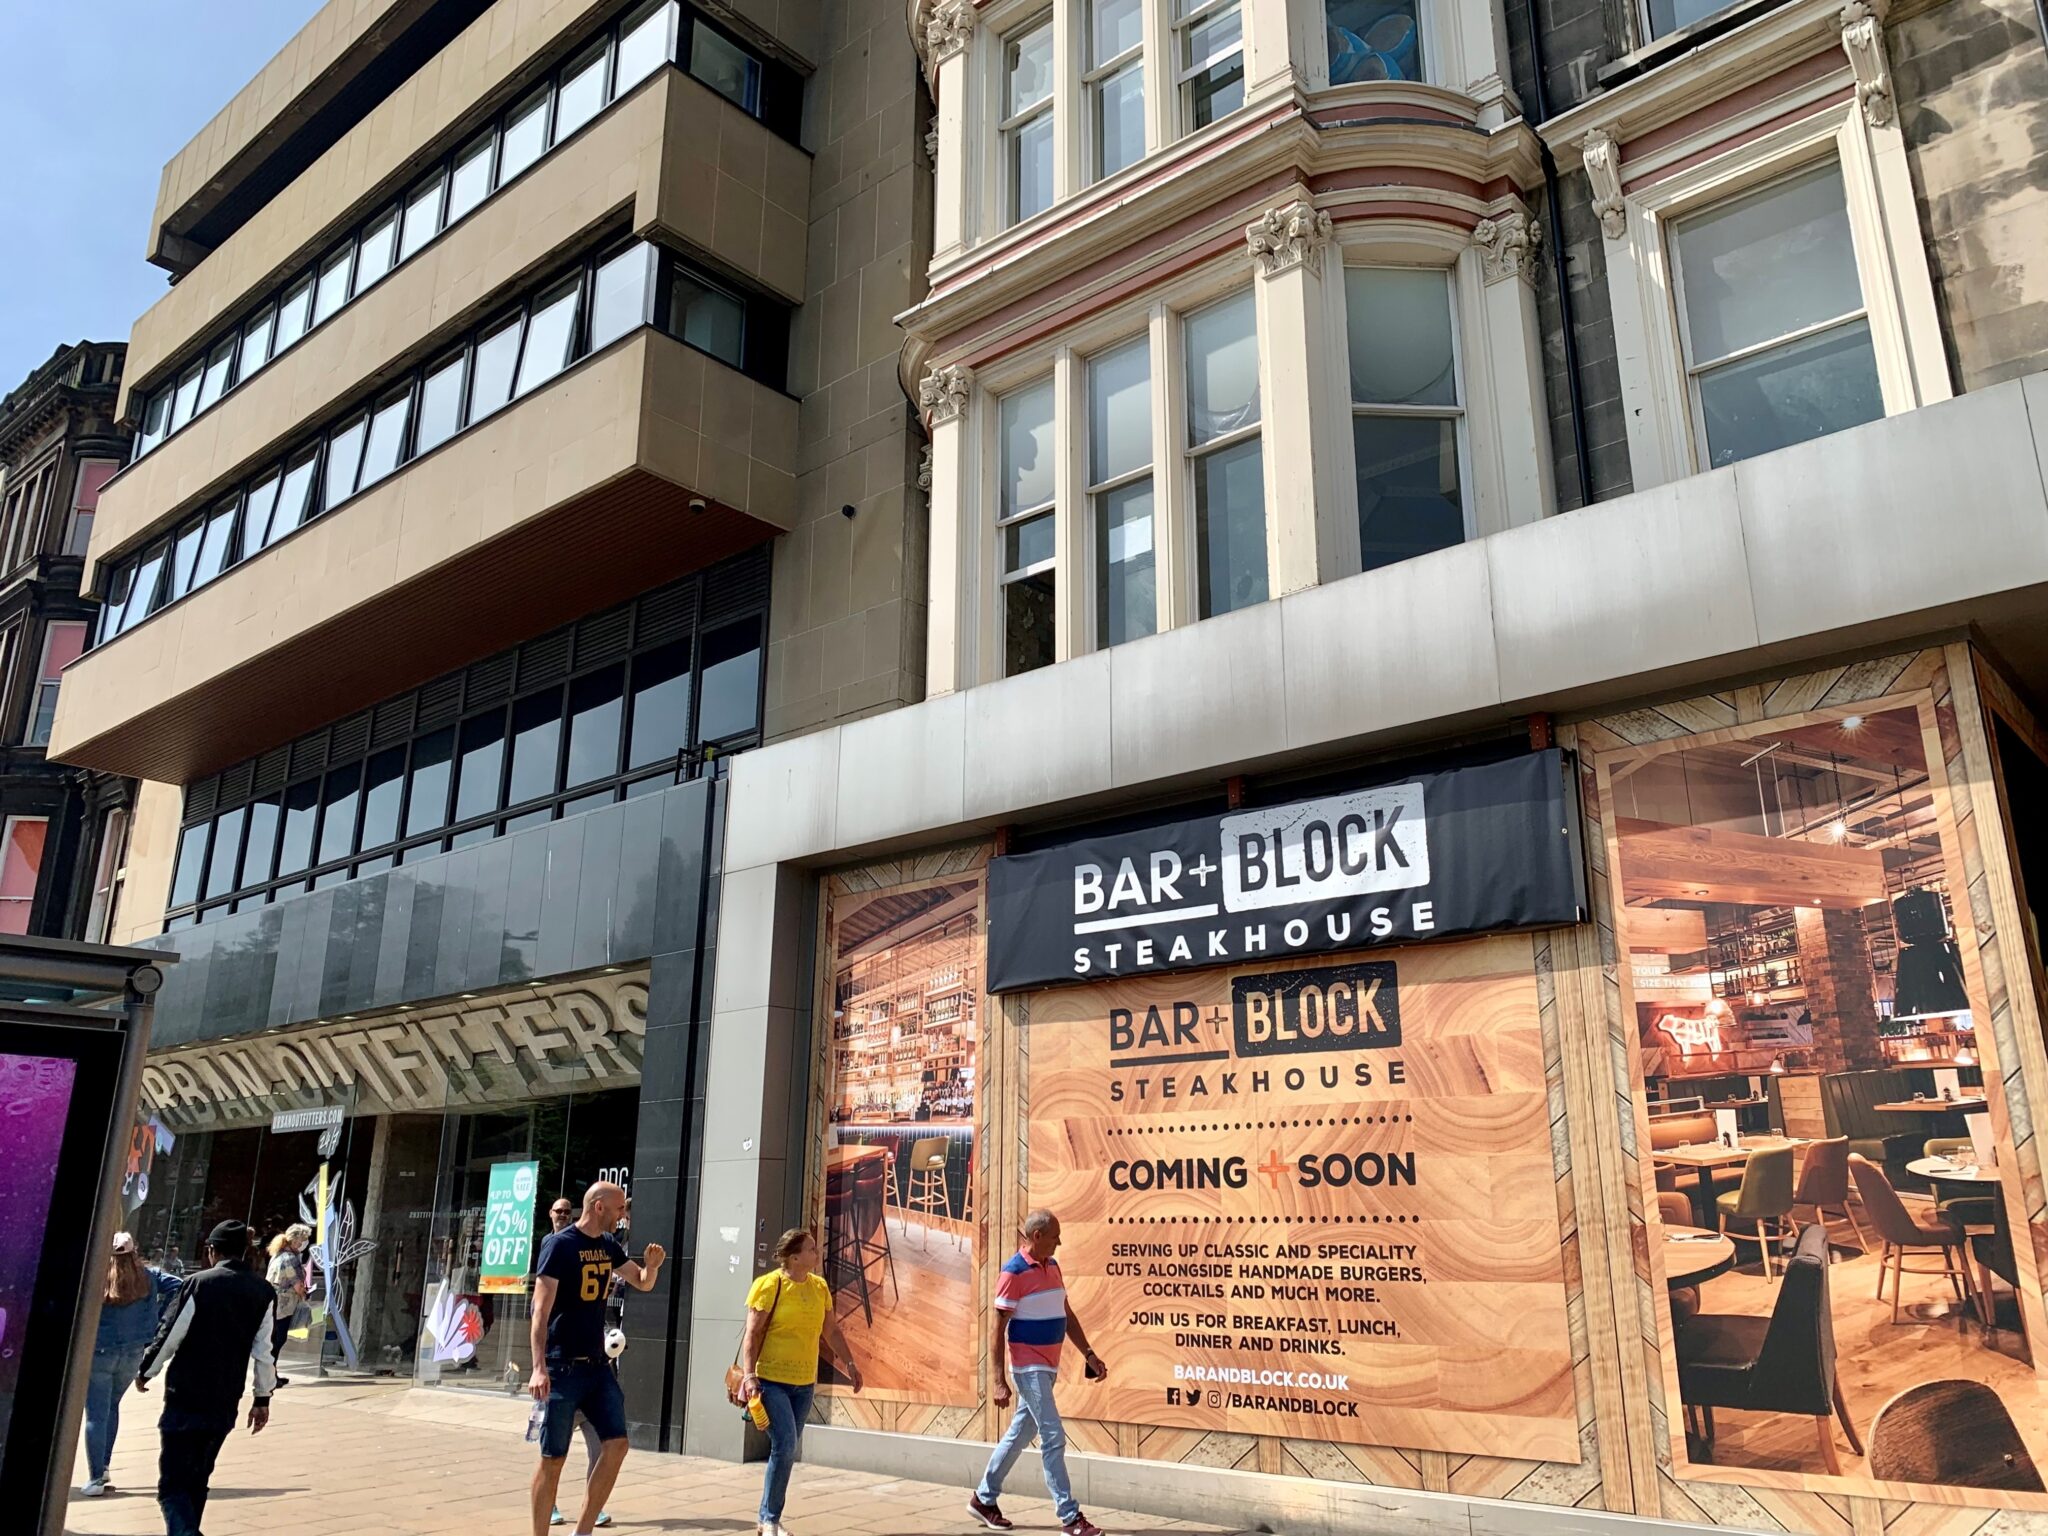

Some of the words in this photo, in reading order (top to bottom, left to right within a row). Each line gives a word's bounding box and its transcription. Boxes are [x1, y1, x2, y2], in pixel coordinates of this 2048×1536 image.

[1239, 805, 1410, 893] BLOCK
[1074, 901, 1435, 973] STEAKHOUSE
[1246, 978, 1387, 1043] BLOCK
[1110, 1061, 1406, 1101] STEAKHOUSE
[273, 1109, 343, 1130] URBANOUTFITTERS.COM
[1109, 1156, 1248, 1191] COMING
[1298, 1152, 1417, 1188] SOON
[490, 1189, 502, 1200] UP
[502, 1189, 512, 1200] TO
[487, 1202, 528, 1236] 75%
[485, 1238, 528, 1266] OFF
[1112, 1243, 1173, 1257] SERVING
[1178, 1244, 1198, 1257] UP
[1204, 1244, 1269, 1259] CLASSIC
[1275, 1244, 1311, 1259] AND
[1318, 1245, 1417, 1260] SPECIALITY
[580, 1262, 612, 1301] 67
[1106, 1263, 1142, 1276] CUTS
[1147, 1263, 1233, 1278] ALONGSIDE
[1239, 1265, 1333, 1280] HANDMADE
[1340, 1266, 1427, 1284] BURGERS,
[1143, 1282, 1225, 1298] COCKTAILS
[1231, 1285, 1265, 1299] AND
[1271, 1286, 1318, 1301] MUCH
[1325, 1287, 1381, 1303] MORE.
[1129, 1312, 1164, 1326] JOIN
[1170, 1313, 1190, 1327] US
[1196, 1314, 1227, 1328] FOR
[1233, 1315, 1331, 1335] BREAKFAST,
[1337, 1319, 1401, 1338] LUNCH,
[1175, 1333, 1232, 1349] DINNER
[1238, 1336, 1273, 1351] AND
[1280, 1338, 1346, 1356] DRINKS.
[1174, 1365, 1349, 1391] BARANDBLOCK.CO.UK
[1225, 1392, 1359, 1417] /BARANDBLOCK
